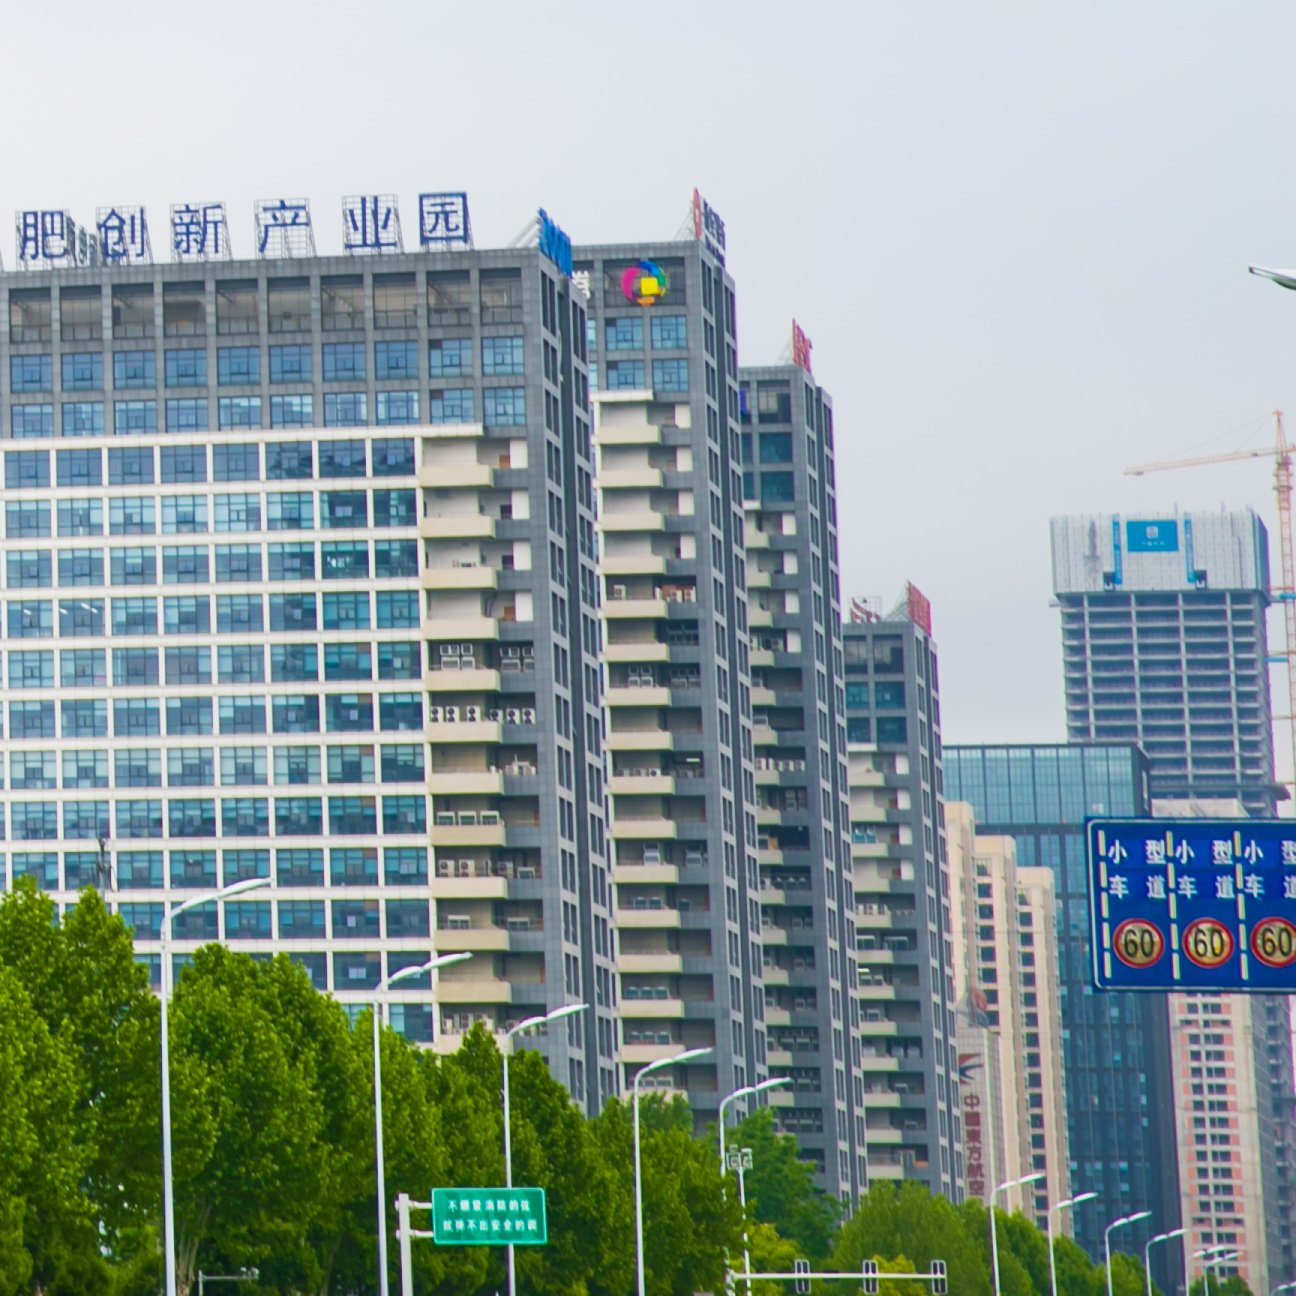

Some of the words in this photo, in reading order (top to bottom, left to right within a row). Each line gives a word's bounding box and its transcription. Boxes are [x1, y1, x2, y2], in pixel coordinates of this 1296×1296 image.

[1108, 839, 1166, 864] 小型
[1175, 839, 1233, 864] 小型
[1109, 874, 1166, 899] 车道
[1177, 875, 1235, 899] 车道
[1124, 929, 1155, 958] 60
[1193, 928, 1225, 958] 60
[1261, 927, 1293, 957] 60
